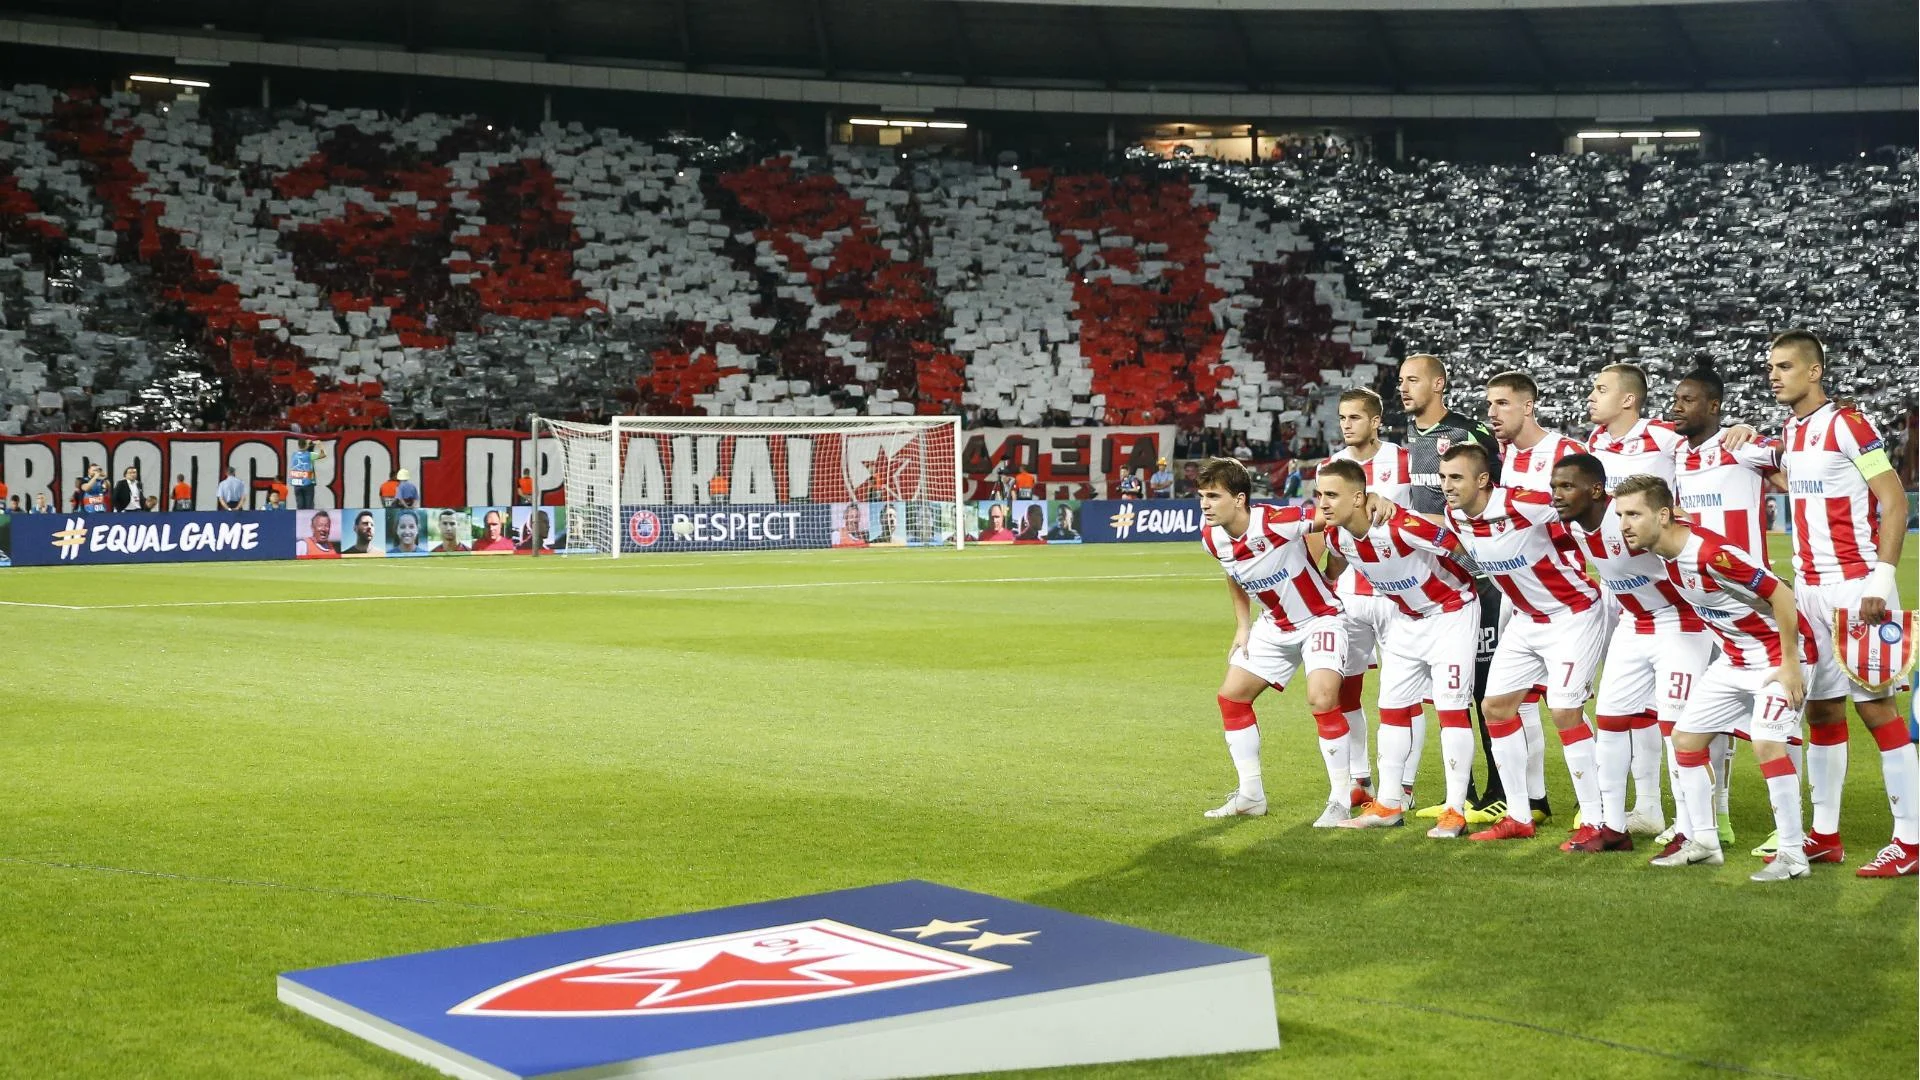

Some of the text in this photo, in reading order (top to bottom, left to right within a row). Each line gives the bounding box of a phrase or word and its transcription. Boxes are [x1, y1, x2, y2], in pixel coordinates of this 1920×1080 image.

[673, 512, 801, 541] RESPECT
[1311, 631, 1335, 653] 30
[1448, 664, 1460, 690] 3
[1562, 661, 1575, 687] 7
[1668, 671, 1692, 701] 31
[1763, 695, 1788, 721] 17
